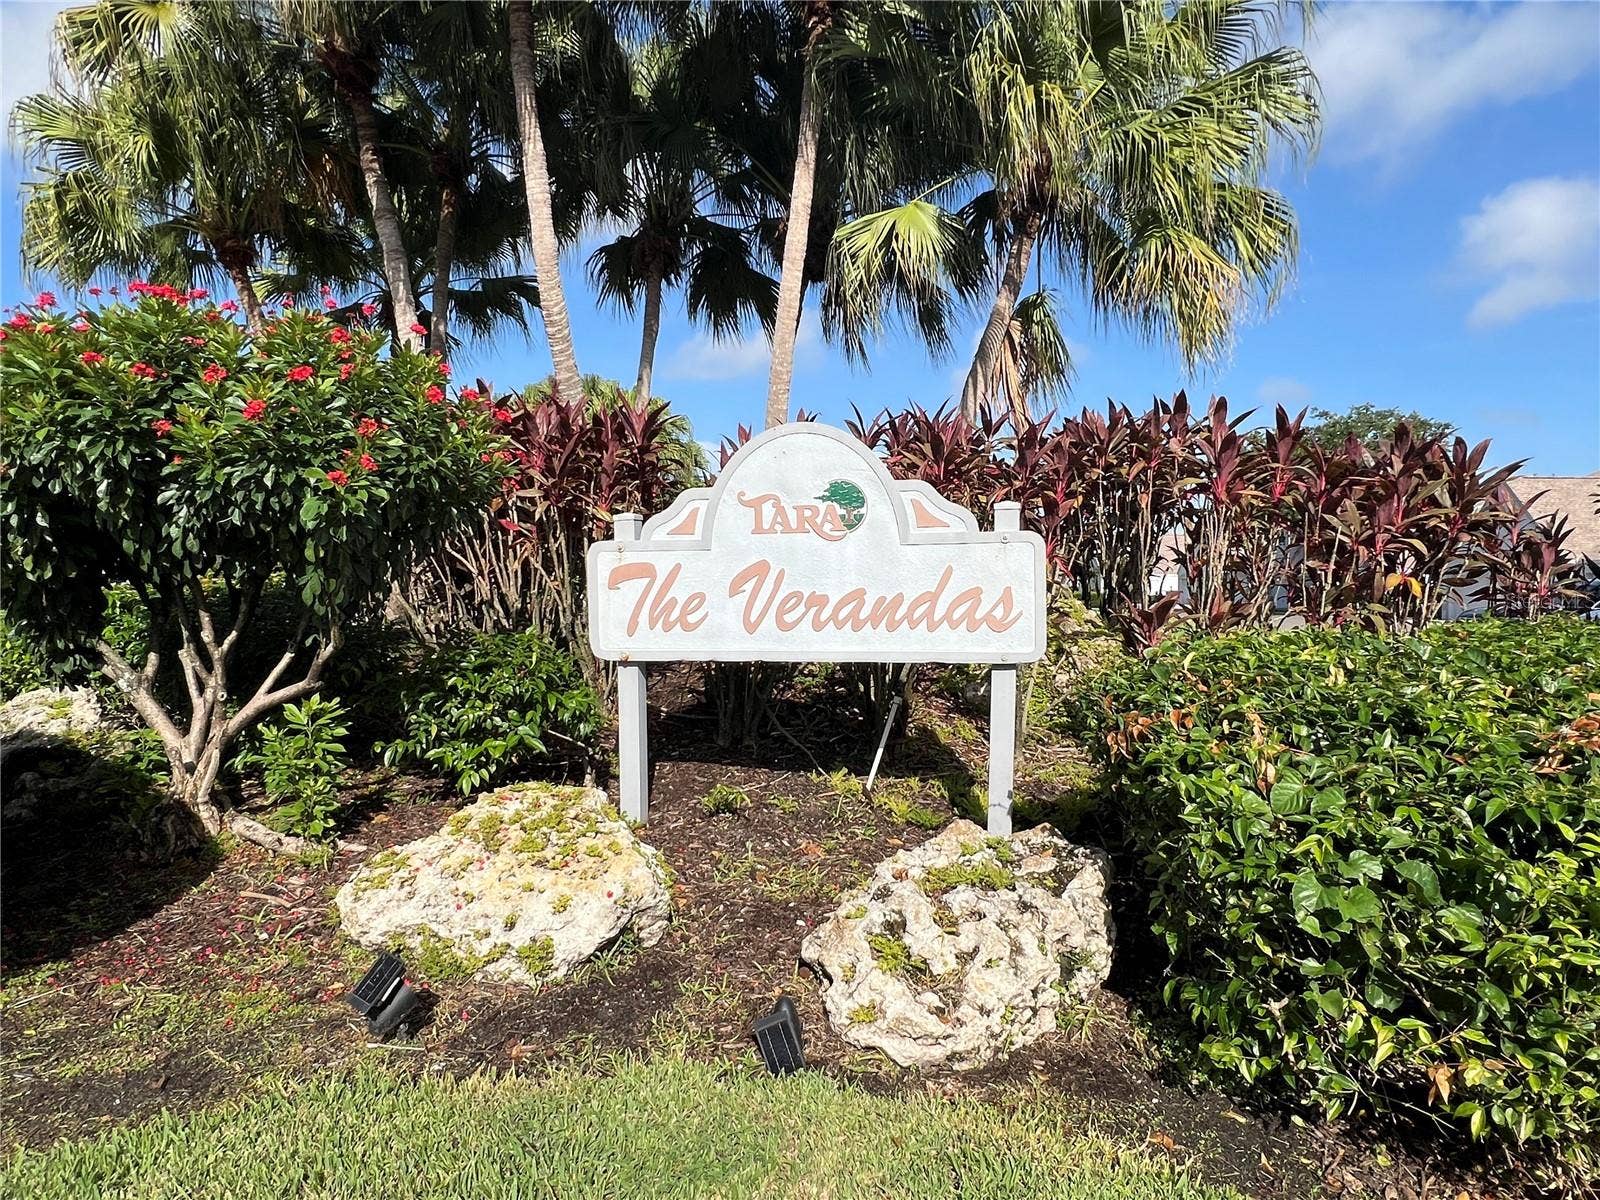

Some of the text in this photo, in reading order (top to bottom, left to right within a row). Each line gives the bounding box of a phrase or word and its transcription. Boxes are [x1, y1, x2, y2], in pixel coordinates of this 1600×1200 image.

[737, 491, 848, 541] TARA
[608, 559, 1023, 637] The Verandas
